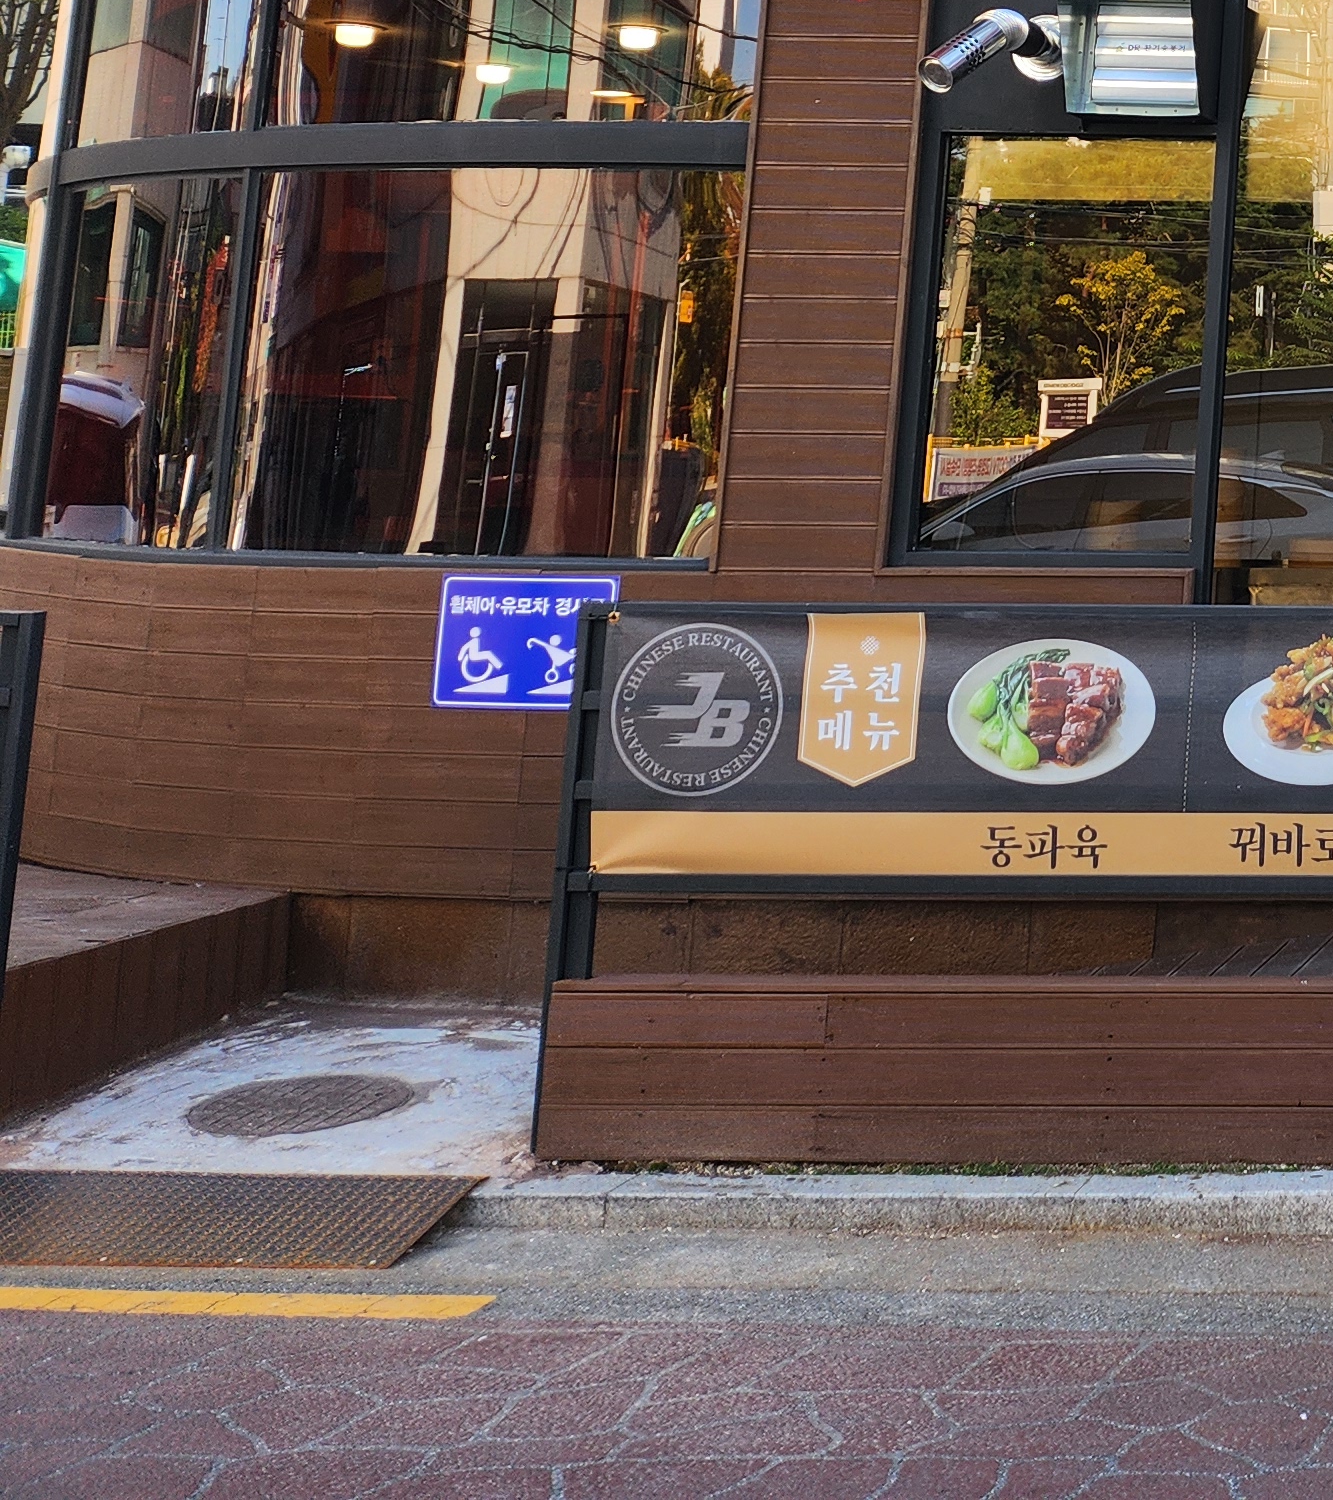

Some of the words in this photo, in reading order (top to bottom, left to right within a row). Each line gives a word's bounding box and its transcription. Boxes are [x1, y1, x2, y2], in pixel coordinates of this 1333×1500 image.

[623, 636, 685, 701] CHINESE
[688, 633, 773, 702] RESTAURANT
[820, 661, 900, 705] 추천
[621, 716, 707, 787] RESTAURANT
[709, 718, 771, 784] CHINESE
[818, 711, 900, 751] 메뉴
[979, 823, 1110, 871] 동파육
